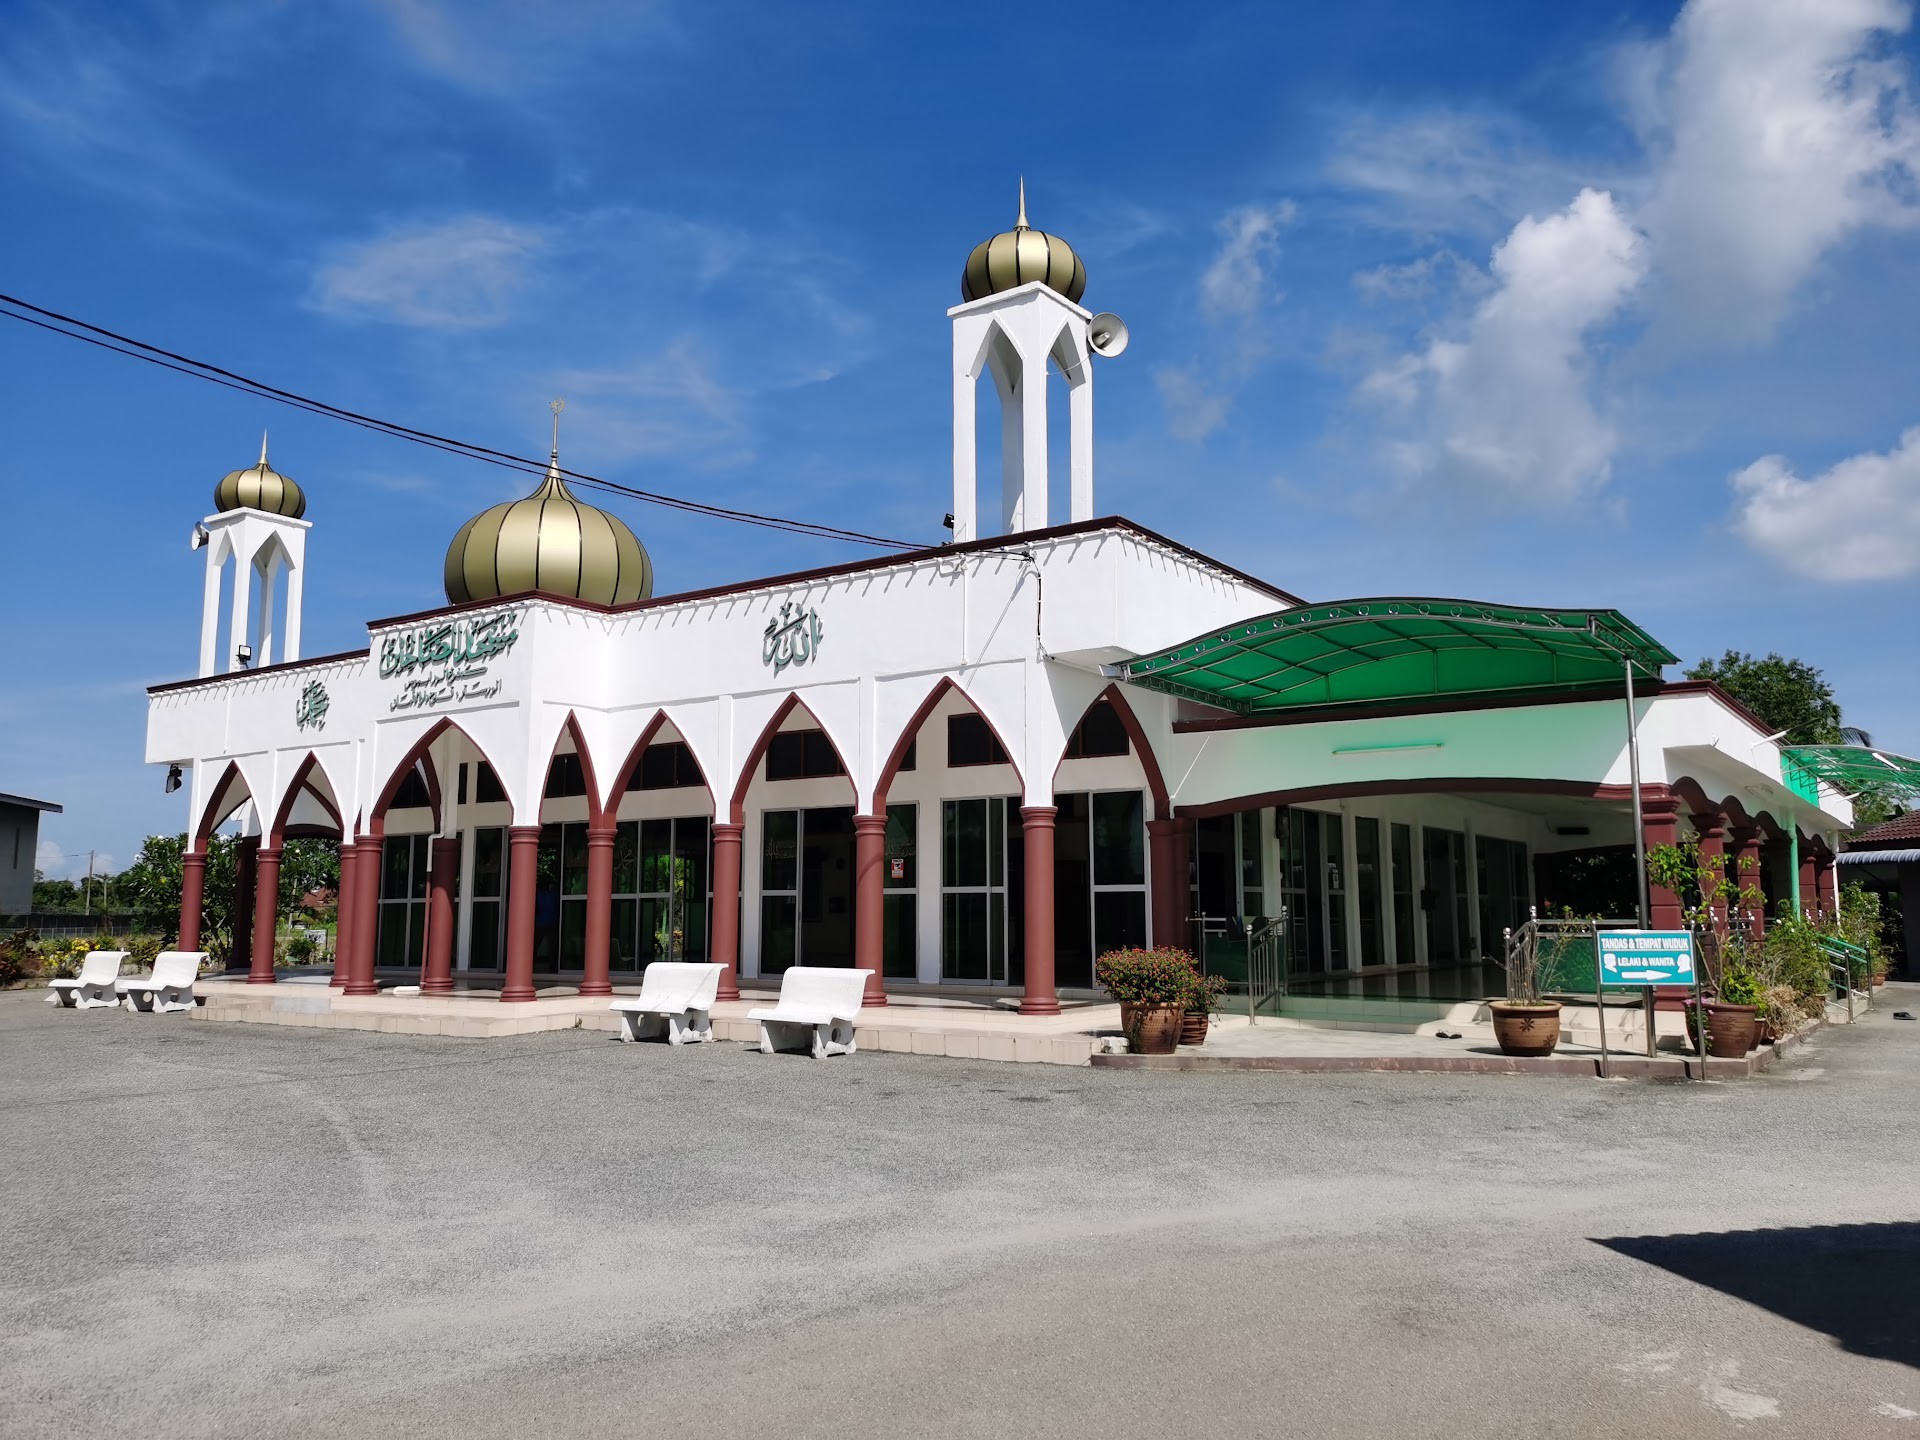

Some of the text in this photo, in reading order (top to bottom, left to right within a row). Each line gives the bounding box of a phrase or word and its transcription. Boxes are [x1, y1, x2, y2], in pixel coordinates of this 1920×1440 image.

[1602, 938, 1688, 949] TANDAS & TEMPAT WUDUK
[1617, 957, 1675, 966] LELAKI & WANITA
